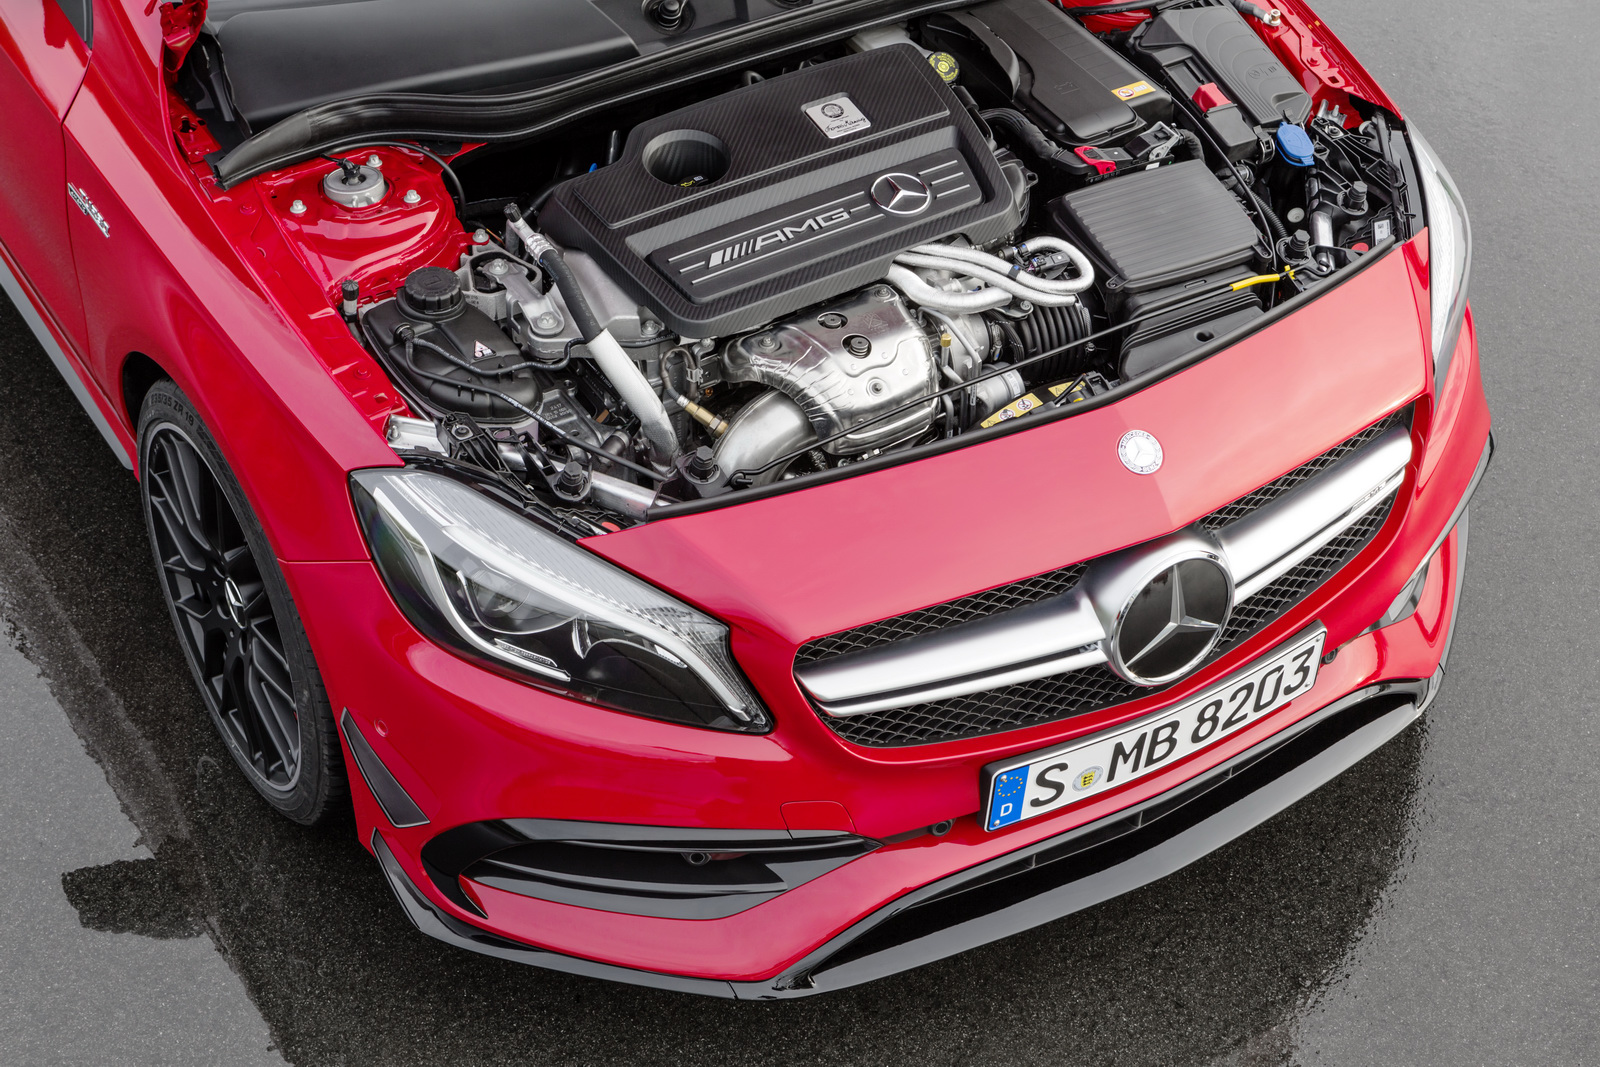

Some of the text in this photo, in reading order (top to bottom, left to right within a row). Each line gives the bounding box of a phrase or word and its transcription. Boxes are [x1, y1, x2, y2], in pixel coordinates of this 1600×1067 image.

[755, 208, 850, 251] AMG
[173, 401, 184, 415] ZR
[185, 412, 194, 426] 19
[1030, 762, 1069, 808] S
[1106, 720, 1180, 783] MB
[1191, 645, 1316, 744] 8203
[1001, 803, 1013, 817] D
